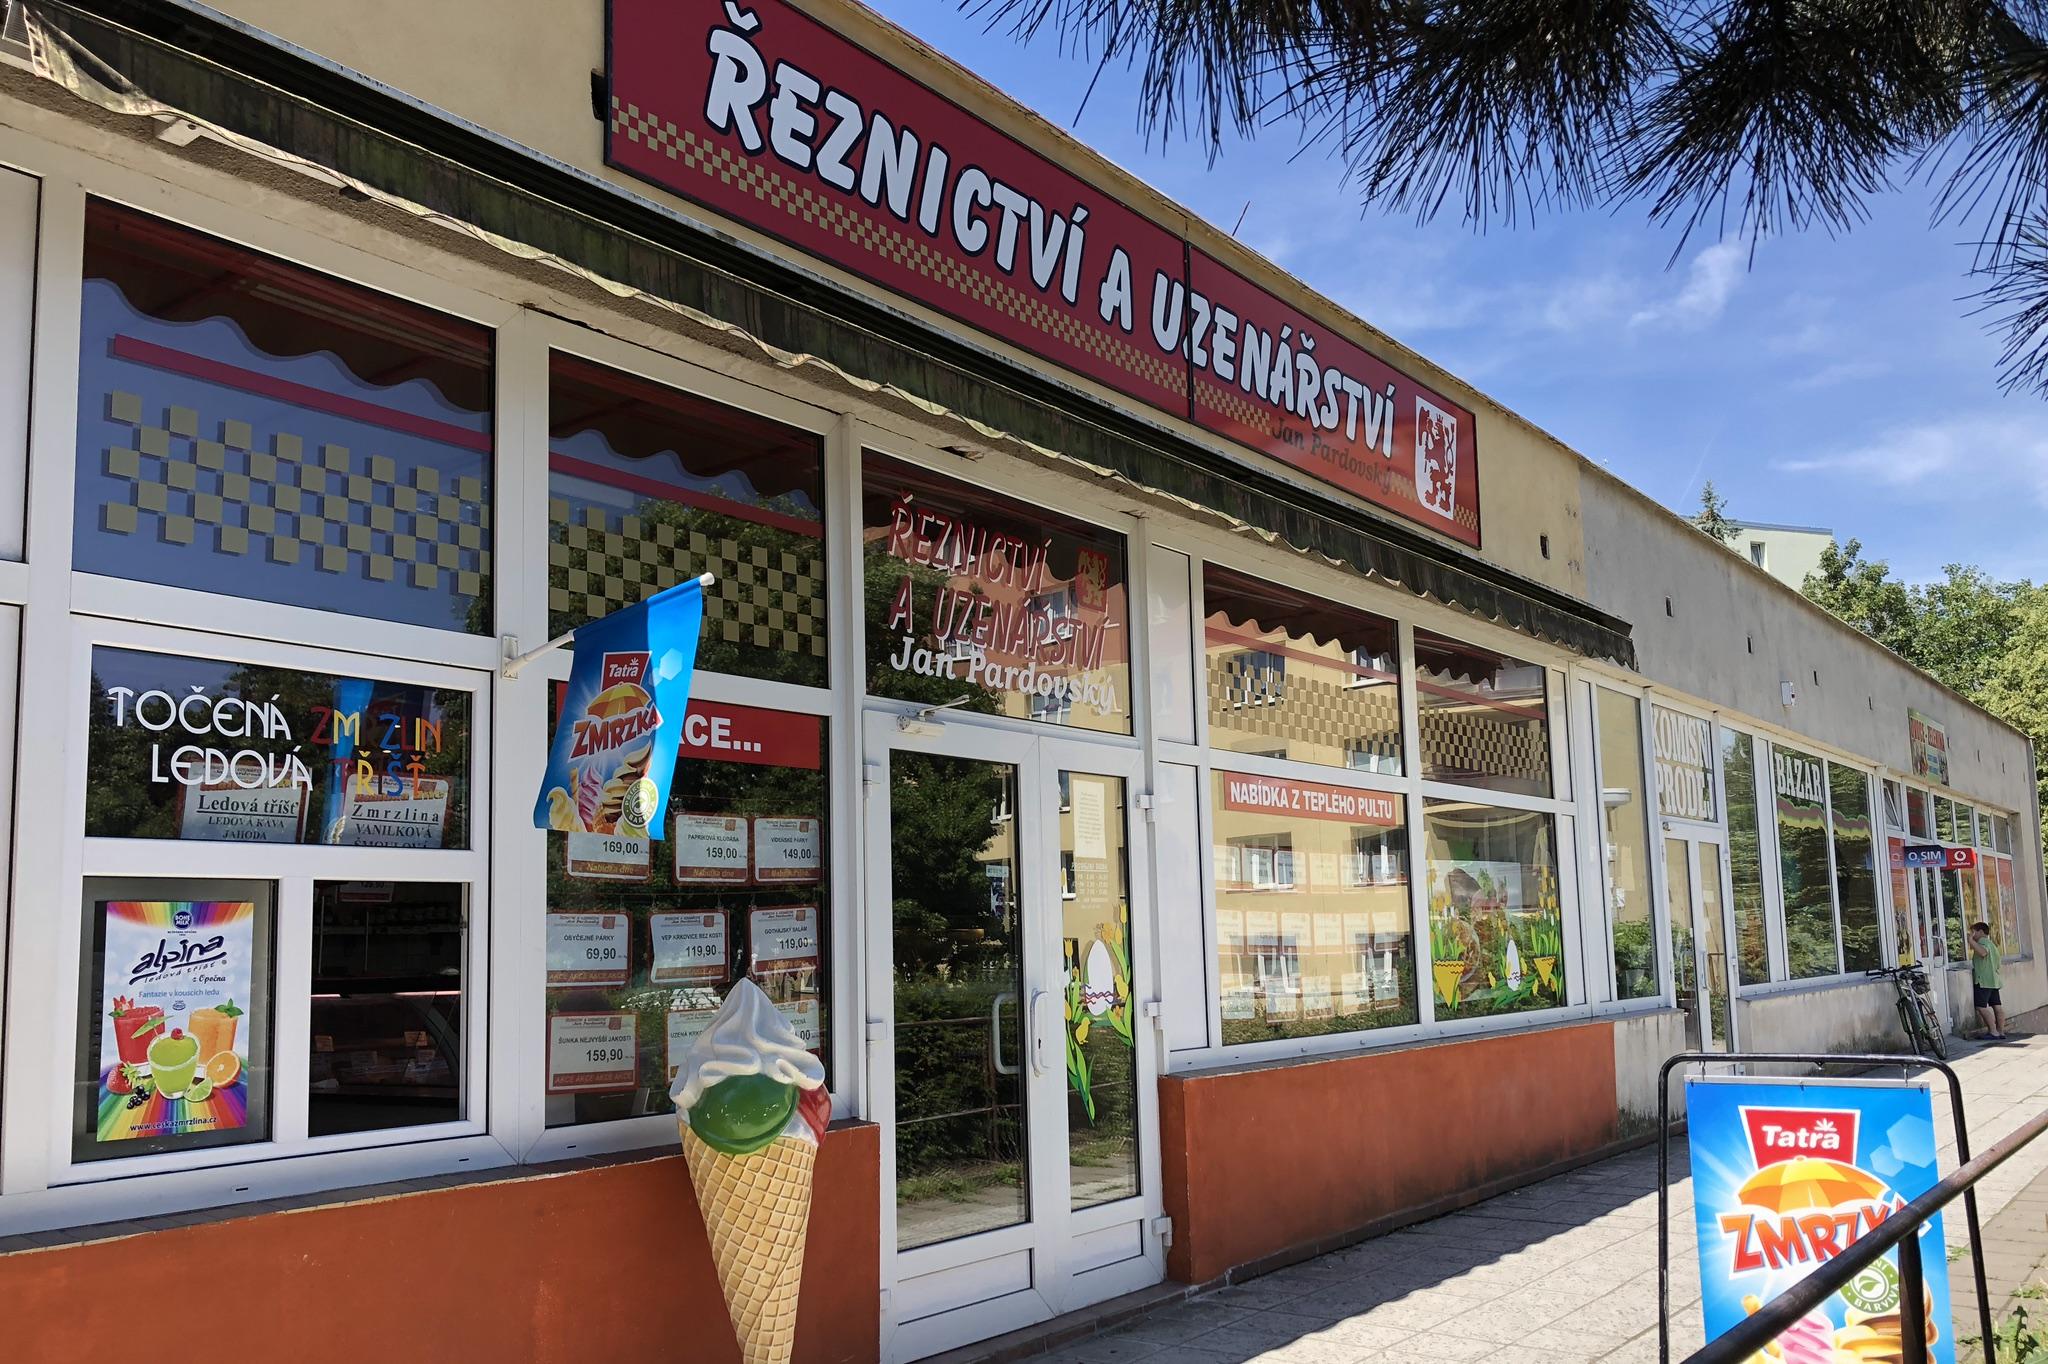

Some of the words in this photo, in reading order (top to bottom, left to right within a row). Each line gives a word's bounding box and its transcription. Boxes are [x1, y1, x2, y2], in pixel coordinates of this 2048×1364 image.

[704, 1, 1088, 303] ŘEZNICTVÍ
[1099, 246, 1133, 333] A
[1151, 269, 1396, 459] UZENÁŘSTVÍ
[1272, 417, 1305, 449] Jan
[1311, 432, 1391, 495] Pardovský
[887, 490, 1051, 595] ŘEZNICTVÍ
[888, 575, 913, 633] A
[932, 587, 1112, 670] UZENÁŘSTVÍ
[609, 660, 639, 678] Tatra
[890, 636, 956, 680] Jan
[966, 650, 1115, 716] Pardovský
[107, 685, 291, 741] TOČENÁ
[680, 714, 762, 753] CE...
[151, 744, 314, 792] LEDOVÁ
[1774, 751, 1824, 804] BAZAR
[1230, 779, 1289, 808] NABÍDKA
[1291, 788, 1300, 810] Z
[1303, 790, 1356, 815] TEPLÉHO
[1358, 798, 1393, 819] PULTU
[1655, 760, 1715, 821] PRODEJ
[198, 794, 258, 813] Ledová
[263, 798, 299, 815] tříšť
[351, 803, 440, 822] Zmrzlina
[222, 829, 267, 841] JAHODA
[355, 822, 433, 839] VANILKOVÁ
[602, 840, 639, 855] 169,00
[705, 846, 738, 860] 159,00
[782, 847, 812, 861] 149,00
[1920, 850, 1942, 861] SIM
[131, 935, 225, 974] alpina
[586, 947, 617, 962] 69,90
[685, 944, 717, 958] 119,90
[779, 937, 809, 951] 119,00
[138, 990, 168, 999] Fantazie
[204, 988, 220, 997] ledu
[586, 1048, 624, 1063] 159,90
[1761, 1122, 1841, 1150] Tatra
[1721, 1197, 1907, 1273] ZMRZK
